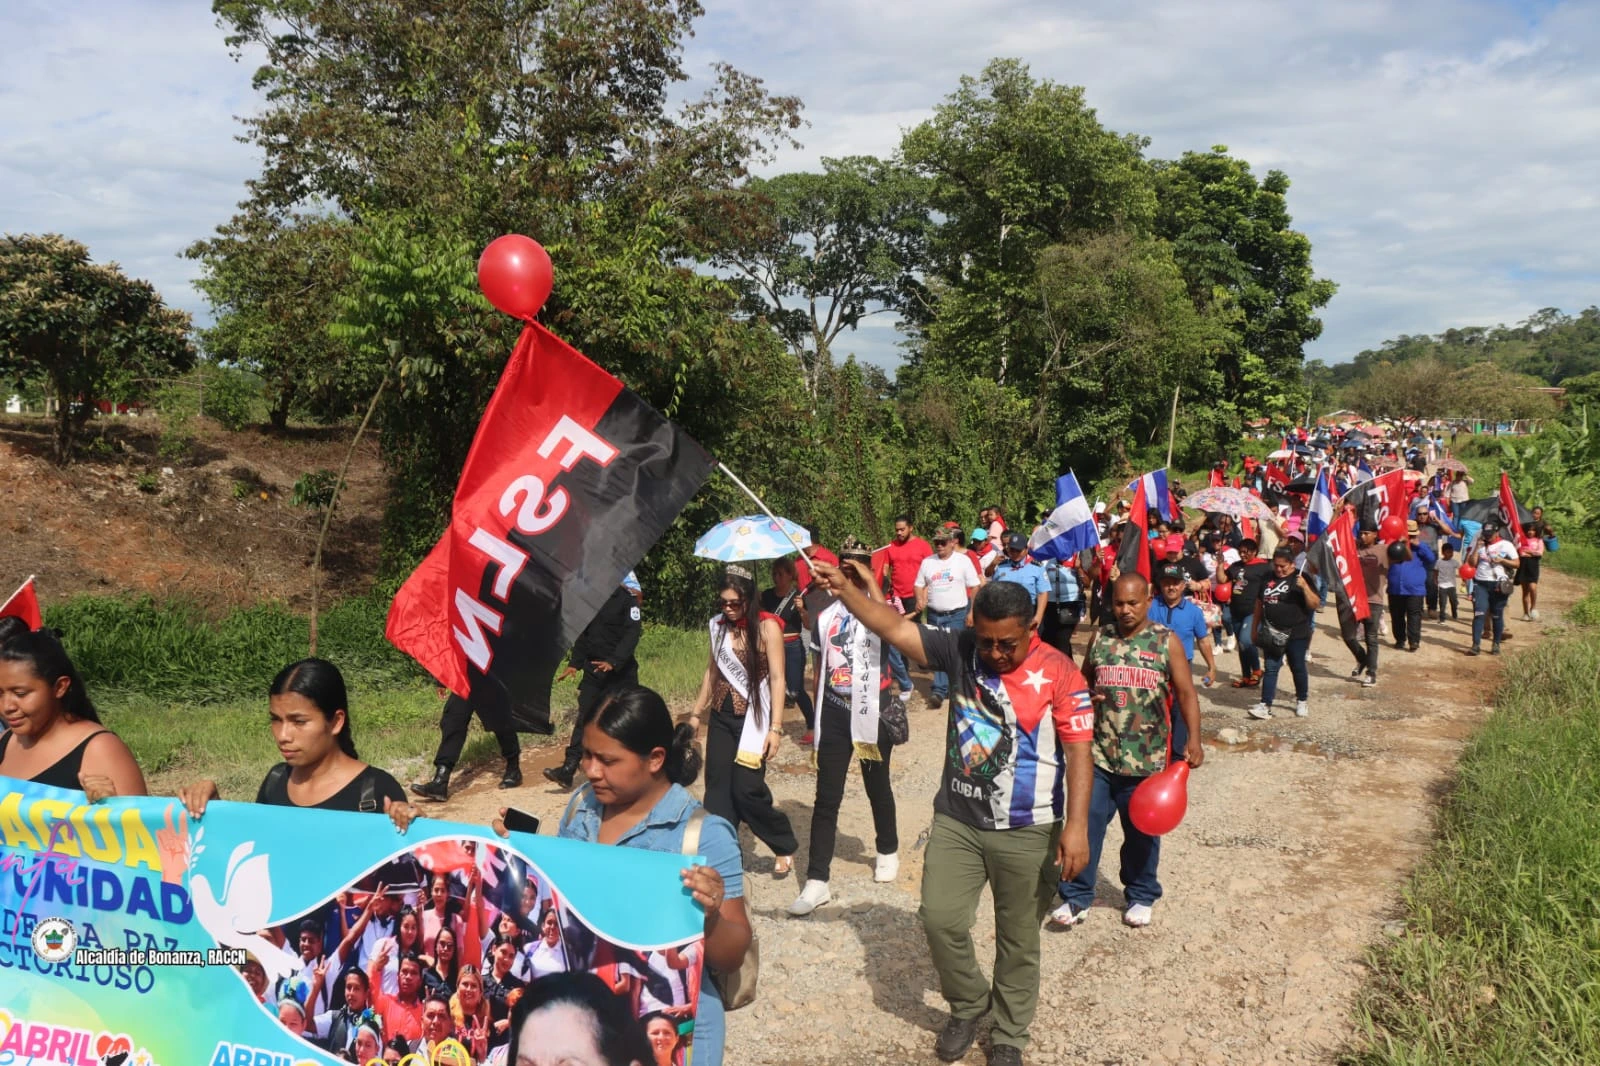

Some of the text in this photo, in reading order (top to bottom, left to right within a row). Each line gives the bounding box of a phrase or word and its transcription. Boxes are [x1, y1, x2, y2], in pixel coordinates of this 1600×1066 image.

[1115, 690, 1127, 707] 3
[951, 777, 983, 801] CUBA
[0, 791, 162, 872] AGUA
[13, 855, 194, 925] UNIDAD
[3, 908, 38, 938] DE
[0, 1022, 98, 1066] ABRIL
